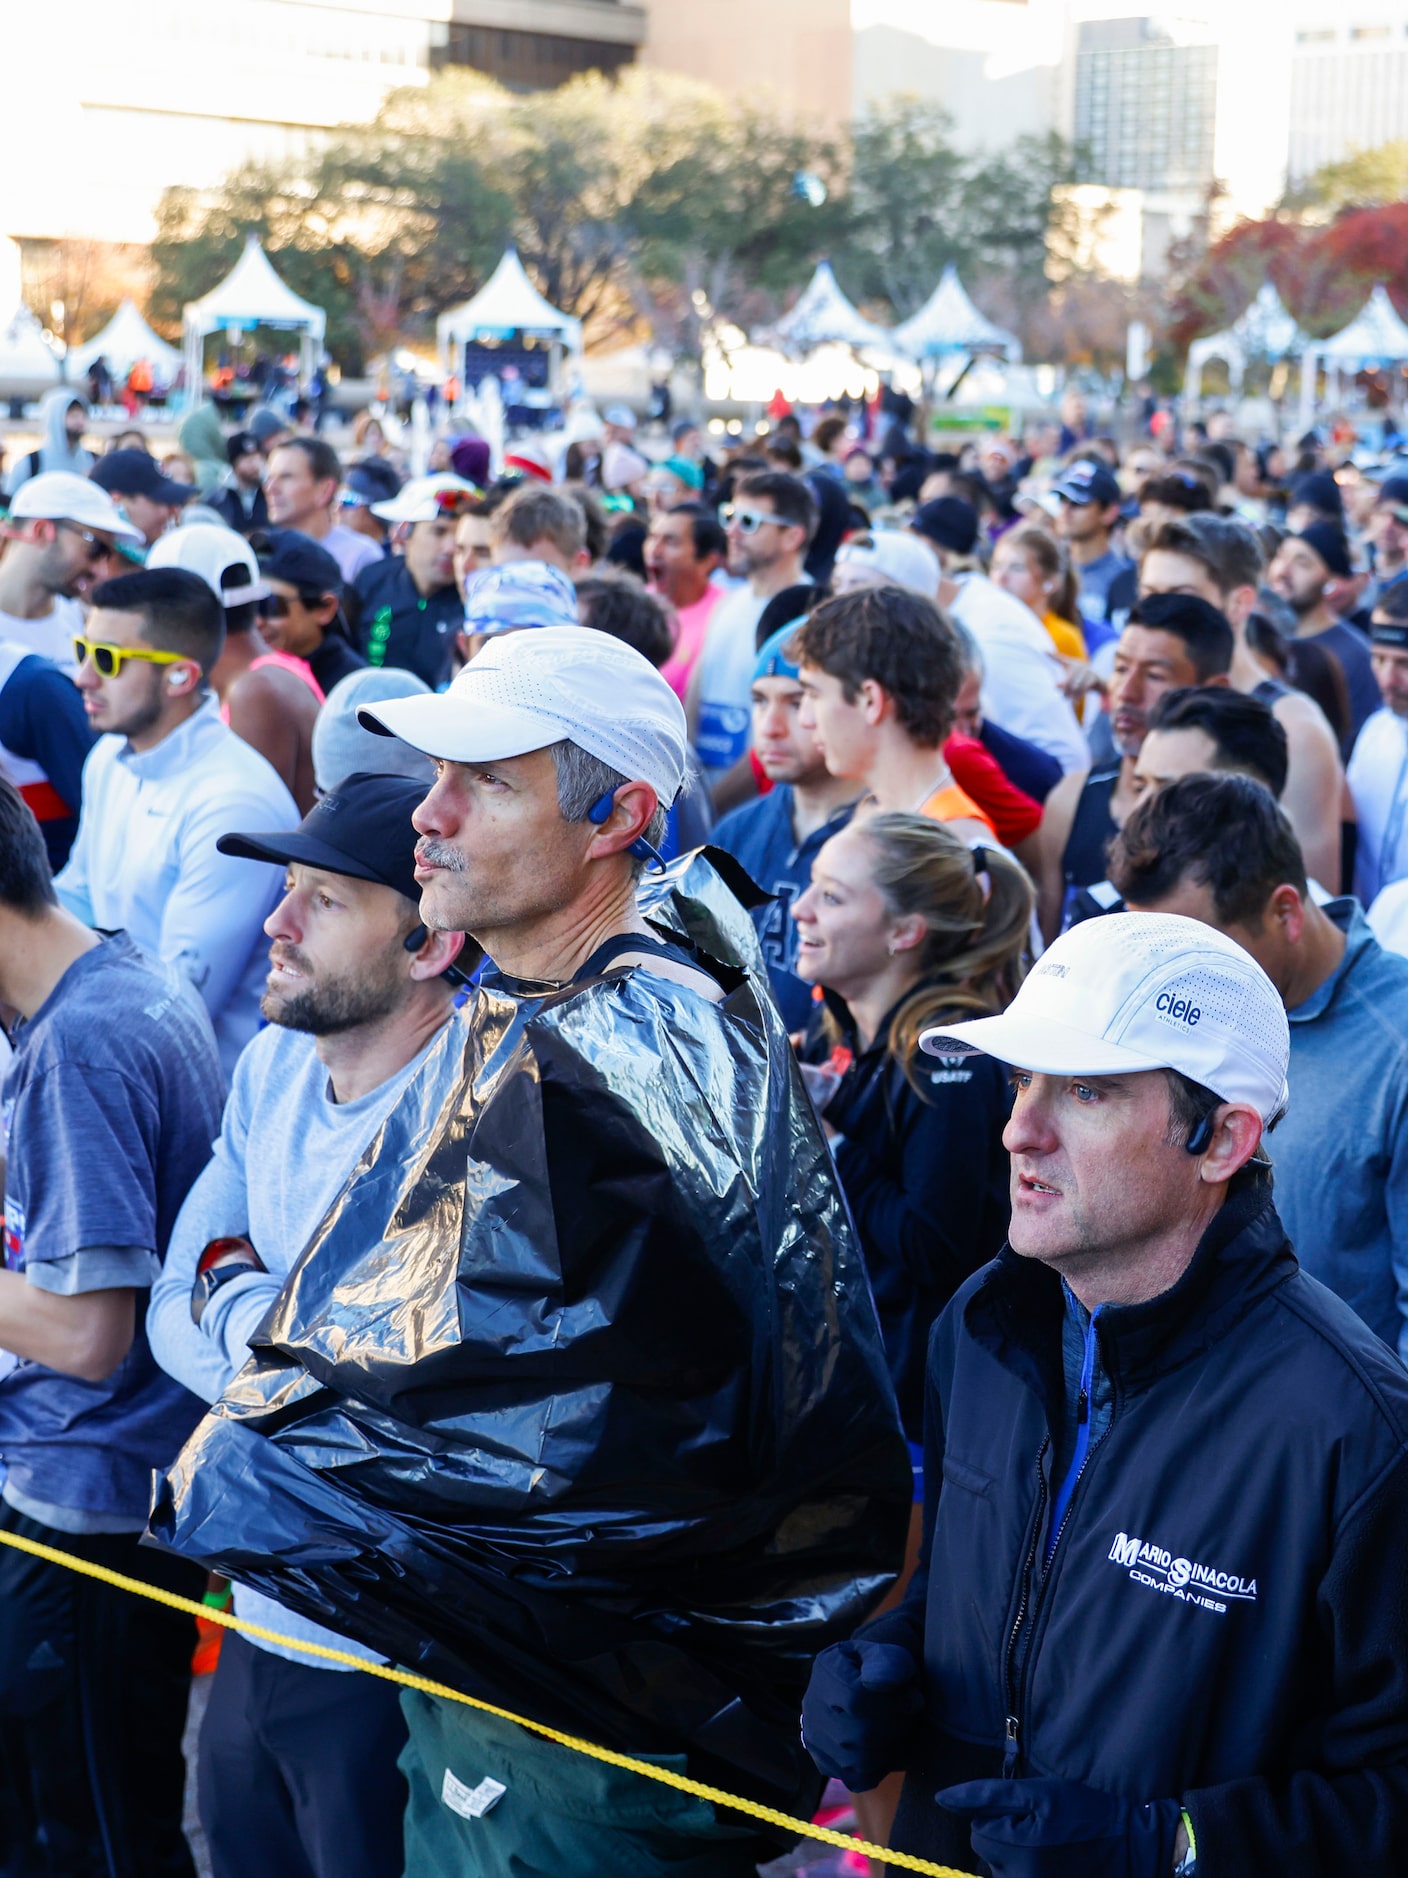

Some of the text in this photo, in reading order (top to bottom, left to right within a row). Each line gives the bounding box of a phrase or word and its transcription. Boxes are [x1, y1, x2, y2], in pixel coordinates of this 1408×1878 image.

[1156, 992, 1201, 1026] ciele
[1158, 1014, 1190, 1035] ATHLETICS
[1108, 1532, 1258, 1595] MARIO SINACOLA
[1129, 1569, 1227, 1614] COMPANIES
